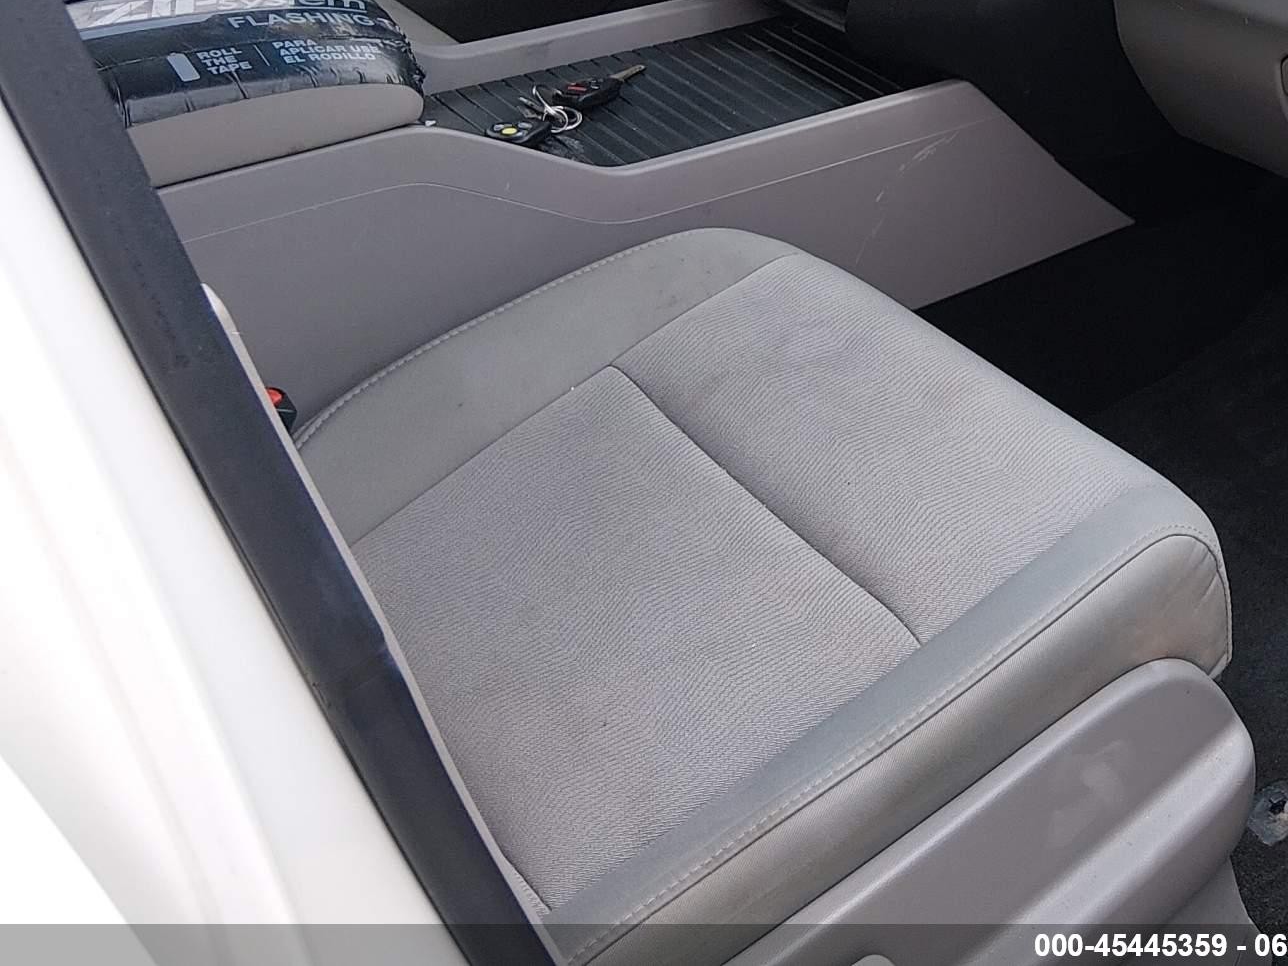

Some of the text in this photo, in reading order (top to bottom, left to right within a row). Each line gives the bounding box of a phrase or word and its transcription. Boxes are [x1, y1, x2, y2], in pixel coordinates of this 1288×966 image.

[228, 10, 375, 29] FLASHING
[272, 38, 318, 50] PARA
[197, 47, 243, 59] ROLL
[279, 45, 347, 57] APLICAR
[201, 56, 238, 67] THE
[284, 51, 376, 64] EL RODILLO
[207, 61, 252, 75] TAPE
